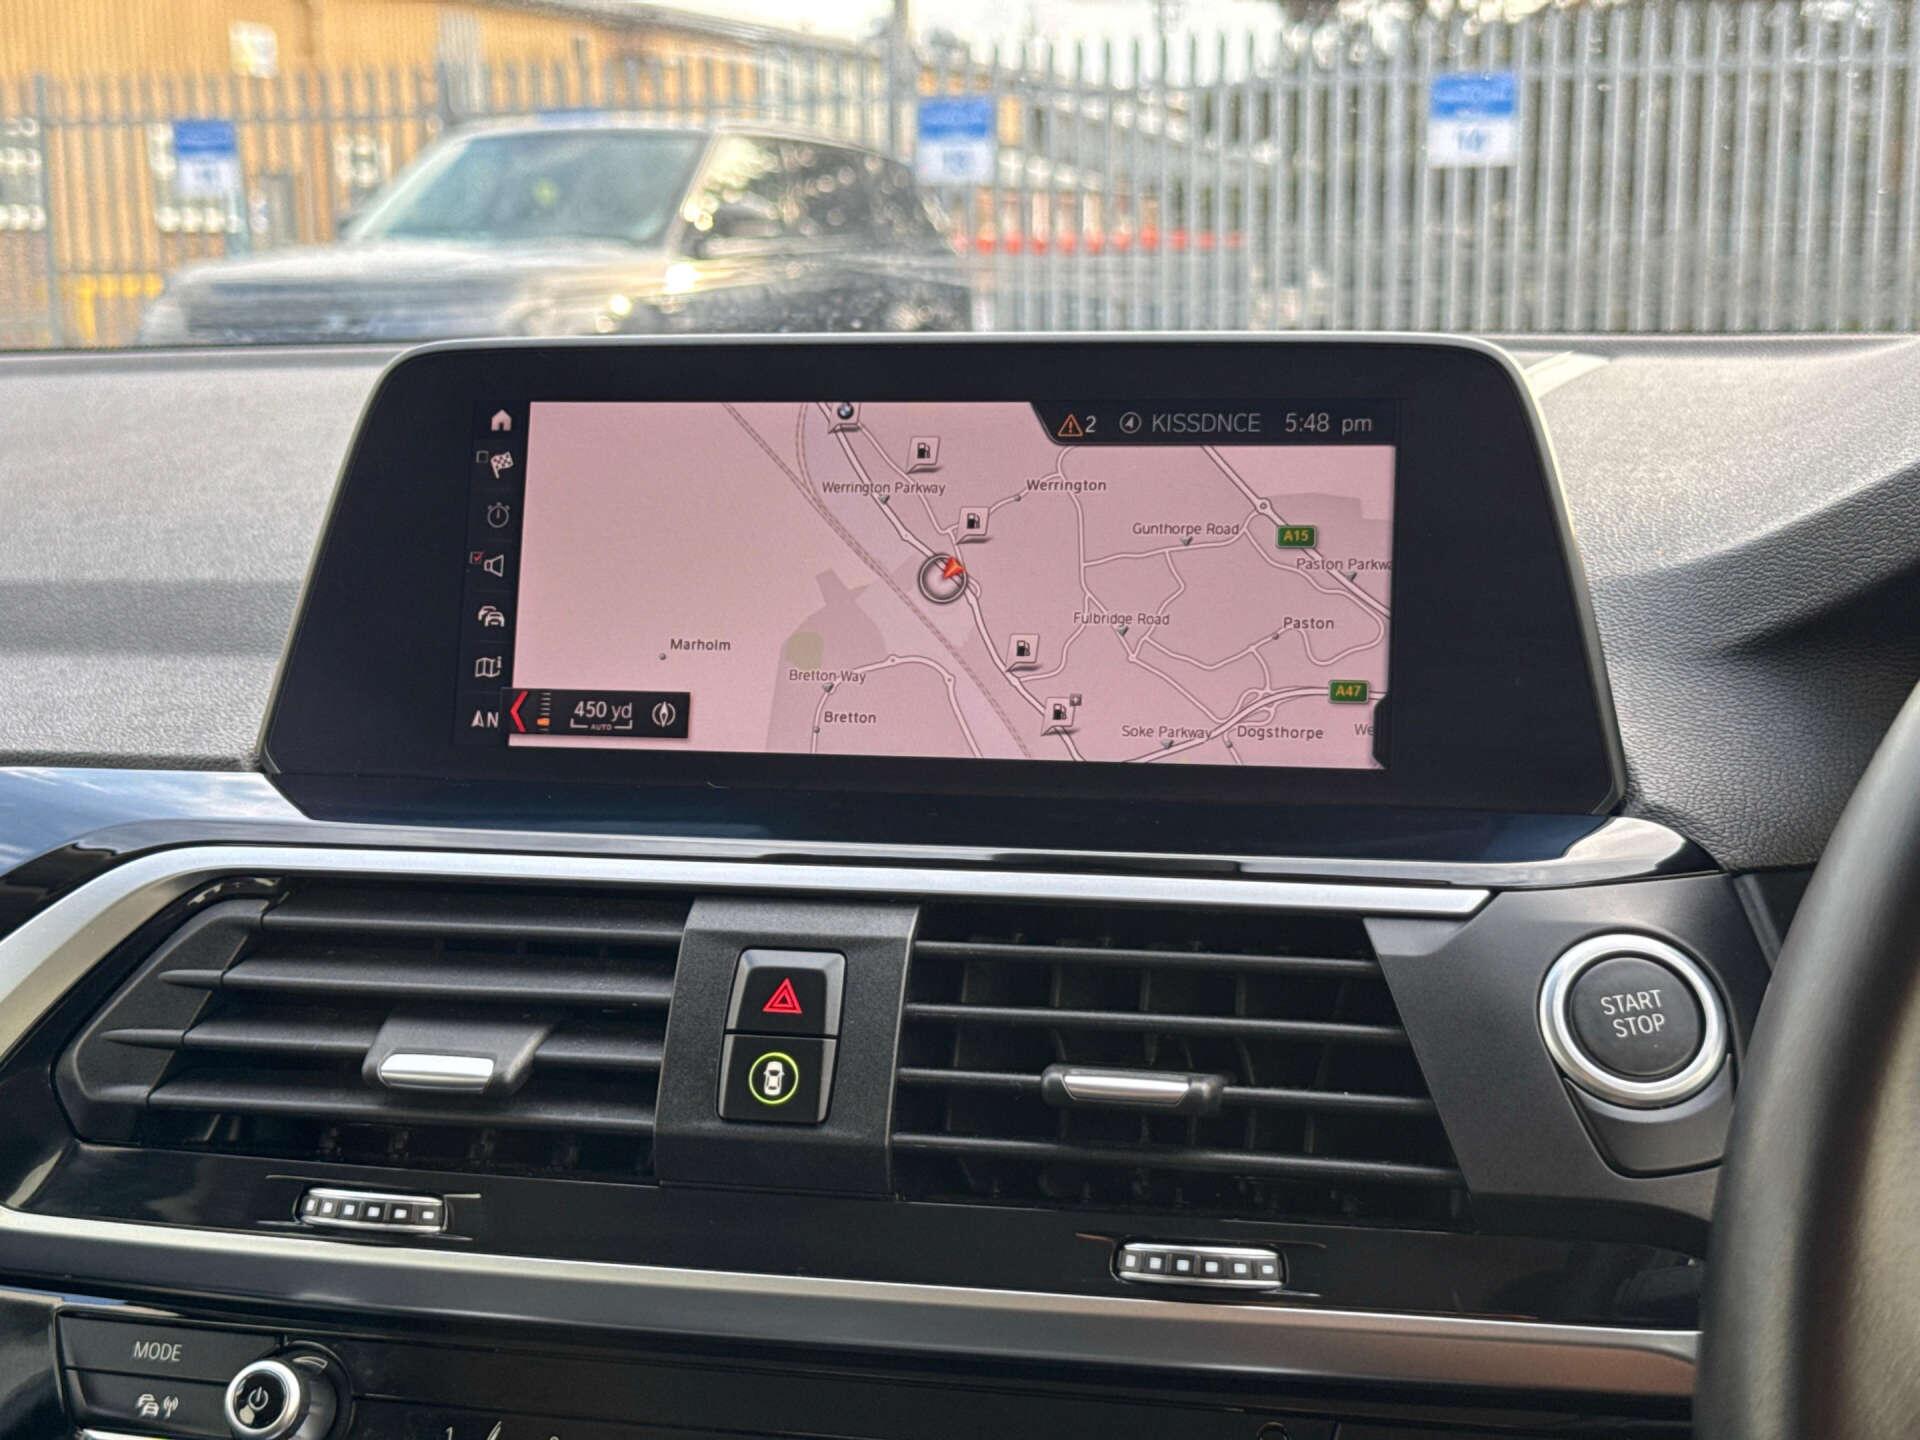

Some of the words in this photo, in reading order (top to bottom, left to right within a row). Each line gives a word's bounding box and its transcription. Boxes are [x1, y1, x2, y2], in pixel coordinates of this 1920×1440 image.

[1085, 416, 1097, 433] 2
[1152, 413, 1261, 433] KISSDNCE
[1285, 412, 1330, 432] 5:48
[1342, 416, 1373, 436] pm
[822, 481, 891, 496] Werrington
[894, 482, 946, 496] Parkway
[1026, 479, 1107, 493] Werrington
[1132, 522, 1202, 537] Gunthorpe
[1206, 522, 1240, 535] Road
[1283, 529, 1309, 542] A15
[1296, 557, 1343, 570] Paston
[1073, 611, 1133, 627] Fulbridge
[1137, 613, 1170, 626] Road
[1283, 616, 1335, 630] Paston
[670, 638, 731, 652] Marholm
[789, 669, 837, 682] Bretton
[841, 670, 867, 684] Way
[1335, 685, 1362, 697] A47
[574, 701, 607, 719] 450
[611, 702, 633, 721] yd
[824, 711, 877, 724] Bretton
[590, 723, 613, 732] AUTO
[1122, 724, 1156, 738] Soke
[1159, 725, 1212, 740] Parkway
[1237, 725, 1324, 741] Dogsthorpe
[1600, 989, 1663, 1016] START
[1613, 1013, 1666, 1038] STOP
[133, 1340, 183, 1361] MODE
